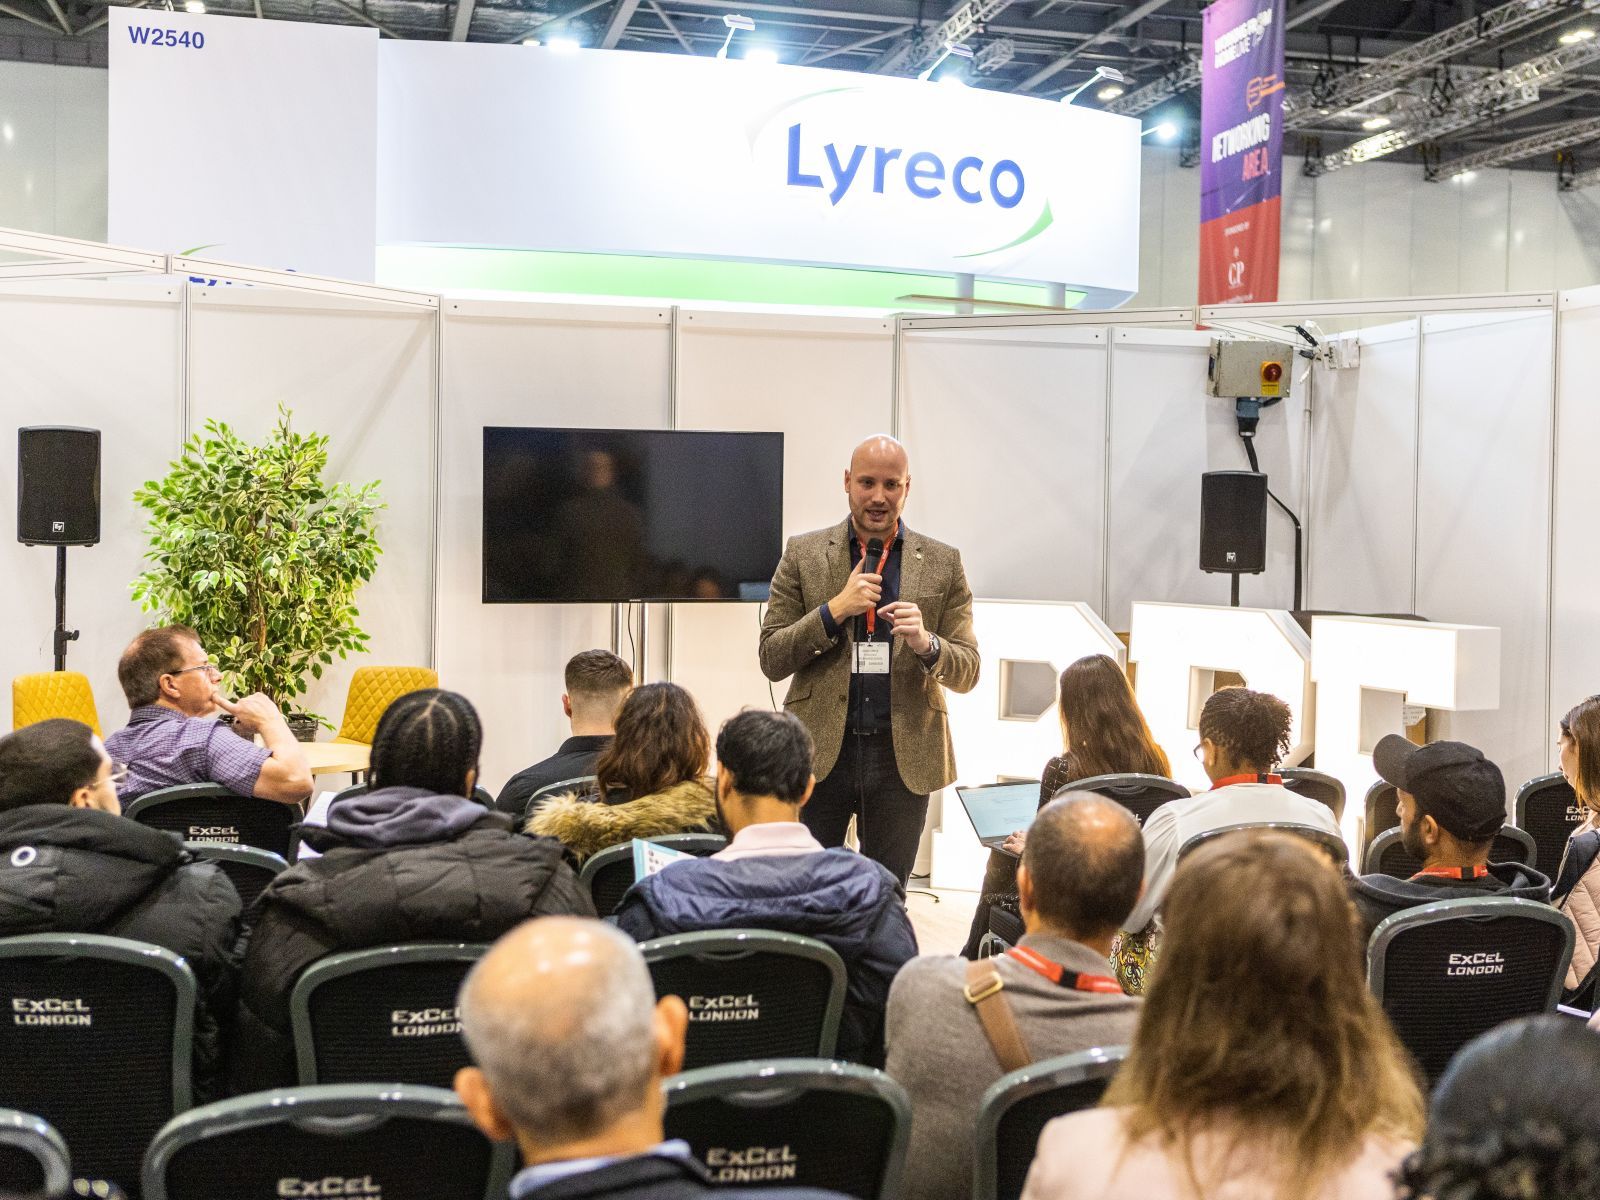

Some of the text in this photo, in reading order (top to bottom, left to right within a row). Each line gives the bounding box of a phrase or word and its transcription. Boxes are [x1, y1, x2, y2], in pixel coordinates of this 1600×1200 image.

[128, 25, 205, 50] W2540
[787, 123, 1025, 209] Lyreco
[1447, 964, 1504, 976] LONDON
[13, 1013, 92, 1026] LONDON
[688, 1007, 760, 1022] LONDON
